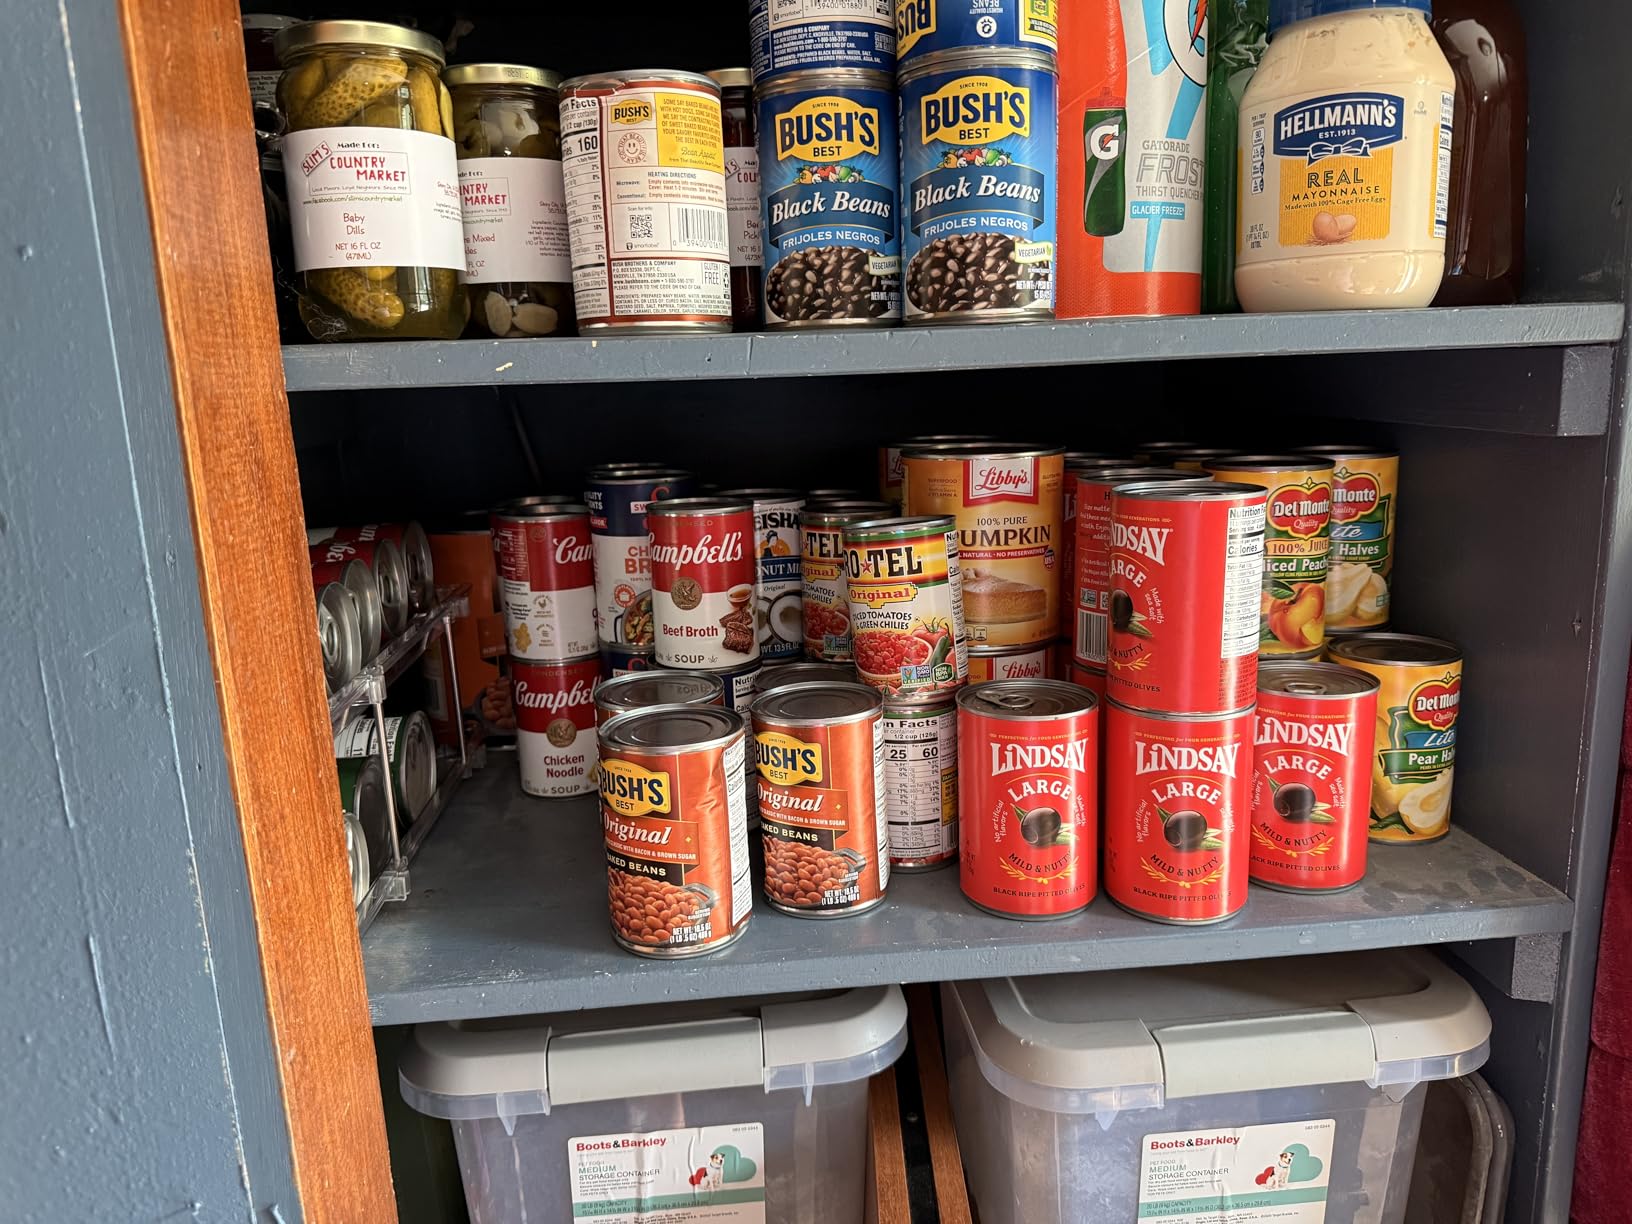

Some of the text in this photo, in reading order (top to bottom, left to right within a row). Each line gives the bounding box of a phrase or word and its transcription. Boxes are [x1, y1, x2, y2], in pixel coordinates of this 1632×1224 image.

[614, 105, 650, 120] BUSH'S
[925, 90, 1025, 135] BUSH'S
[1280, 99, 1397, 141] HELLMANN'S
[780, 108, 876, 154] BUSH'S
[959, 128, 990, 140] BEST
[1318, 129, 1356, 139] EST.1913
[577, 135, 598, 151] 160
[1090, 124, 1120, 160] G
[1142, 140, 1190, 154] GATORADE
[302, 144, 330, 173] SLIM'S
[813, 146, 842, 157] BEST
[330, 156, 386, 169] COUNTRY
[356, 170, 406, 182] MARKET
[1136, 153, 1204, 188] FROST
[1307, 168, 1364, 188] REAL
[460, 183, 488, 195] NTRY
[914, 175, 1041, 213] Black Beans
[1136, 185, 1200, 200] THIRST QUENCHER
[1292, 185, 1380, 202] MAYONNAISE
[465, 195, 507, 206] MARKET
[1284, 202, 1302, 211] Made
[1303, 200, 1317, 209] with
[1318, 199, 1335, 207] 100%
[1336, 198, 1354, 207] Cage
[1355, 197, 1369, 205] Free
[772, 192, 825, 226] Black
[832, 191, 891, 218] Beans
[1131, 205, 1160, 215] GLACIER
[343, 213, 365, 224] Baby
[346, 225, 365, 235] Dills
[924, 216, 1028, 238] FRIJOLES NEGROS
[473, 233, 496, 244] Mixed
[783, 230, 881, 250] FRIJOLES NEGROS
[335, 243, 348, 251] NET
[1018, 247, 1046, 258] VEGETARIAN
[704, 272, 719, 285] FREE
[974, 466, 1028, 490] Libby's
[1333, 488, 1375, 502] Monte
[1274, 502, 1297, 516] Del
[755, 511, 800, 530] EISHA
[977, 516, 1028, 526] 100% PURE
[1293, 519, 1319, 529] Quality
[960, 525, 1051, 547] UMPKIN
[1331, 526, 1362, 538] ite
[806, 532, 843, 558] TEL
[1111, 520, 1169, 566] NDSAY
[1273, 542, 1305, 554] 100%
[1339, 544, 1379, 556] Halves
[1264, 559, 1297, 572] liced
[1111, 559, 1147, 588] ARGE
[764, 584, 786, 592] Original
[850, 587, 911, 602] Original
[811, 594, 832, 605] CHILIES
[1150, 587, 1164, 624] Made with
[867, 611, 912, 621] TOMATOES
[663, 624, 719, 637] Beef Broth
[860, 620, 909, 630] GREEN CHILIES
[1118, 643, 1144, 658] NUTTY
[674, 654, 705, 664] SOUP
[1134, 682, 1161, 693] OLIVES
[1416, 696, 1438, 711] Del
[899, 719, 938, 728] Facts
[1424, 730, 1455, 747] Lite
[755, 742, 817, 776] BUSH'S
[890, 749, 907, 759] 25
[922, 746, 939, 758] 60
[1408, 752, 1438, 766] Pear
[543, 753, 584, 766] Chicken
[546, 766, 584, 778] Noodle
[769, 769, 788, 780] BEST
[1264, 755, 1332, 780] LARGE
[551, 785, 580, 794] SOUP
[601, 769, 664, 806] BUSH'S
[1008, 780, 1071, 802] LARGE
[1151, 782, 1222, 805] LARGE
[616, 799, 635, 811] BEST
[757, 784, 824, 812] Original
[777, 812, 788, 820] WITH
[788, 814, 804, 823] BACON
[809, 817, 828, 826] BROWN
[604, 812, 672, 844] Original
[1260, 822, 1283, 843] MILD
[1294, 829, 1327, 847] NUTTY
[782, 829, 819, 842] BEANS
[623, 845, 634, 853] WITH
[635, 847, 650, 856] BACON
[1008, 852, 1033, 872] MILD
[1044, 850, 1072, 873] NUTTY
[1150, 854, 1175, 875] MILD
[1187, 856, 1219, 877] NUTTY
[1267, 860, 1340, 872] RIPE PITTED OLIVES
[629, 862, 666, 876] BEANS
[993, 887, 1017, 897] BLACK
[1133, 886, 1160, 898] BLACK
[1179, 894, 1207, 902] PITTED
[578, 1165, 616, 1174] MEDIUM
[579, 1168, 660, 1181] STORAGE CONTAINER
[1149, 1167, 1229, 1181] STORAGE CONTAINER
[1150, 1164, 1187, 1173] MEDIUM
